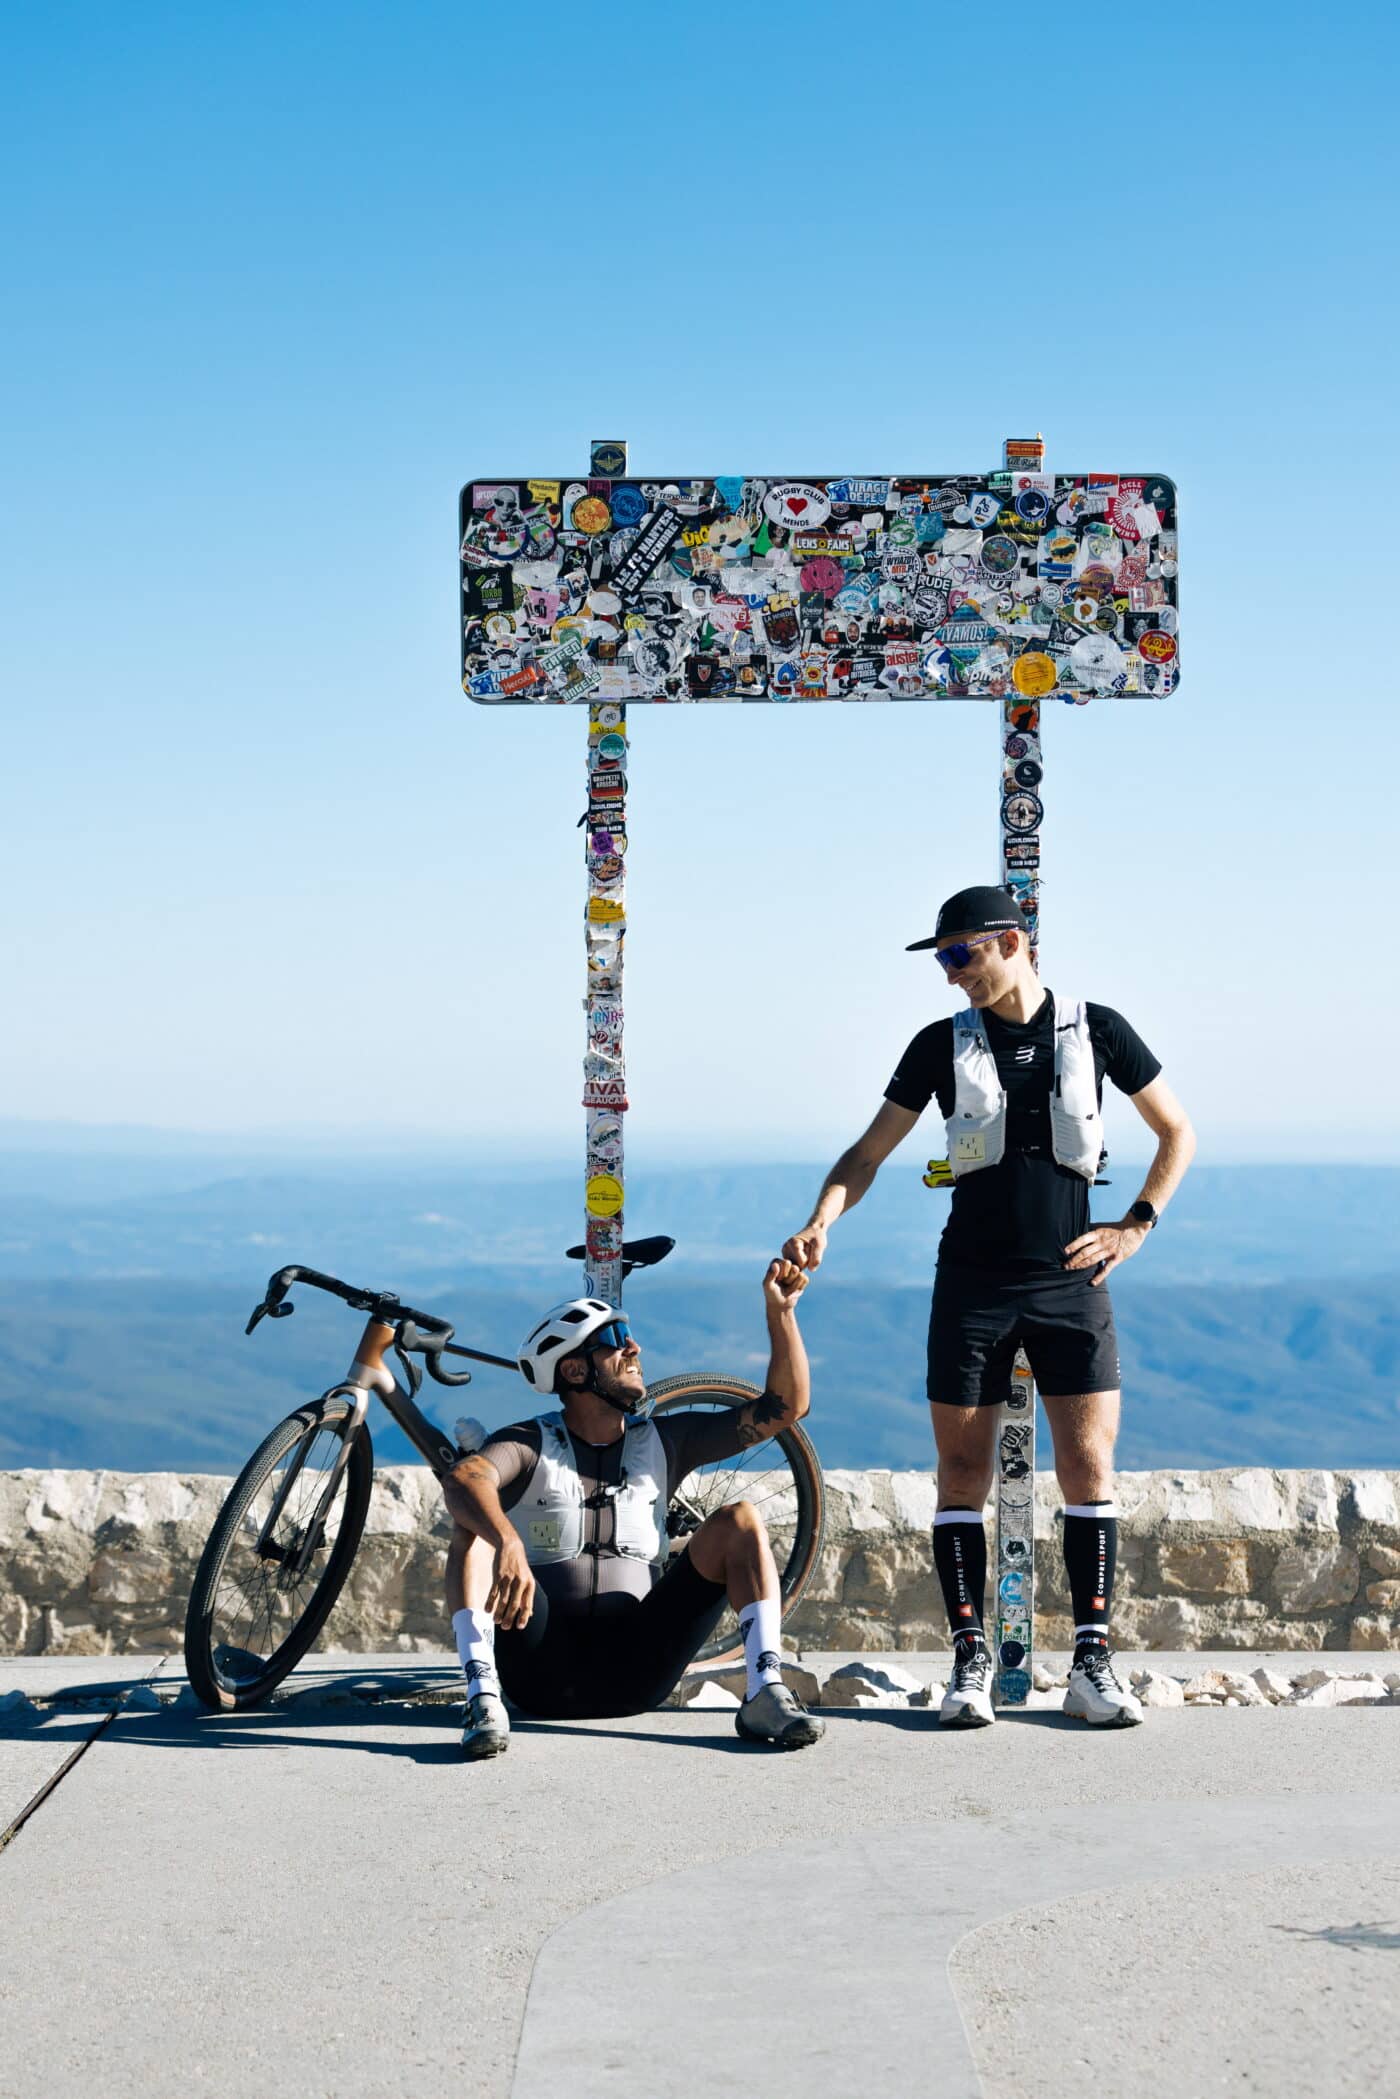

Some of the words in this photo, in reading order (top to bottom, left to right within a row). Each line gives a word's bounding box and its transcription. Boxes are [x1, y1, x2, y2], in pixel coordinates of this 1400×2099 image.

[772, 487, 801, 501] RUGBY
[803, 488, 825, 505] CLUB
[849, 482, 888, 493] VIRAGE
[615, 567, 631, 584] LE
[627, 552, 642, 570] FC
[637, 509, 675, 554] NANTES
[797, 539, 817, 549] LENS
[827, 539, 850, 551] FANS
[624, 570, 643, 593] EST
[640, 563, 650, 572] A
[646, 523, 678, 562] VENDRE
[918, 573, 952, 590] RUDE
[1097, 1529, 1106, 1595] COMPRESSPORT
